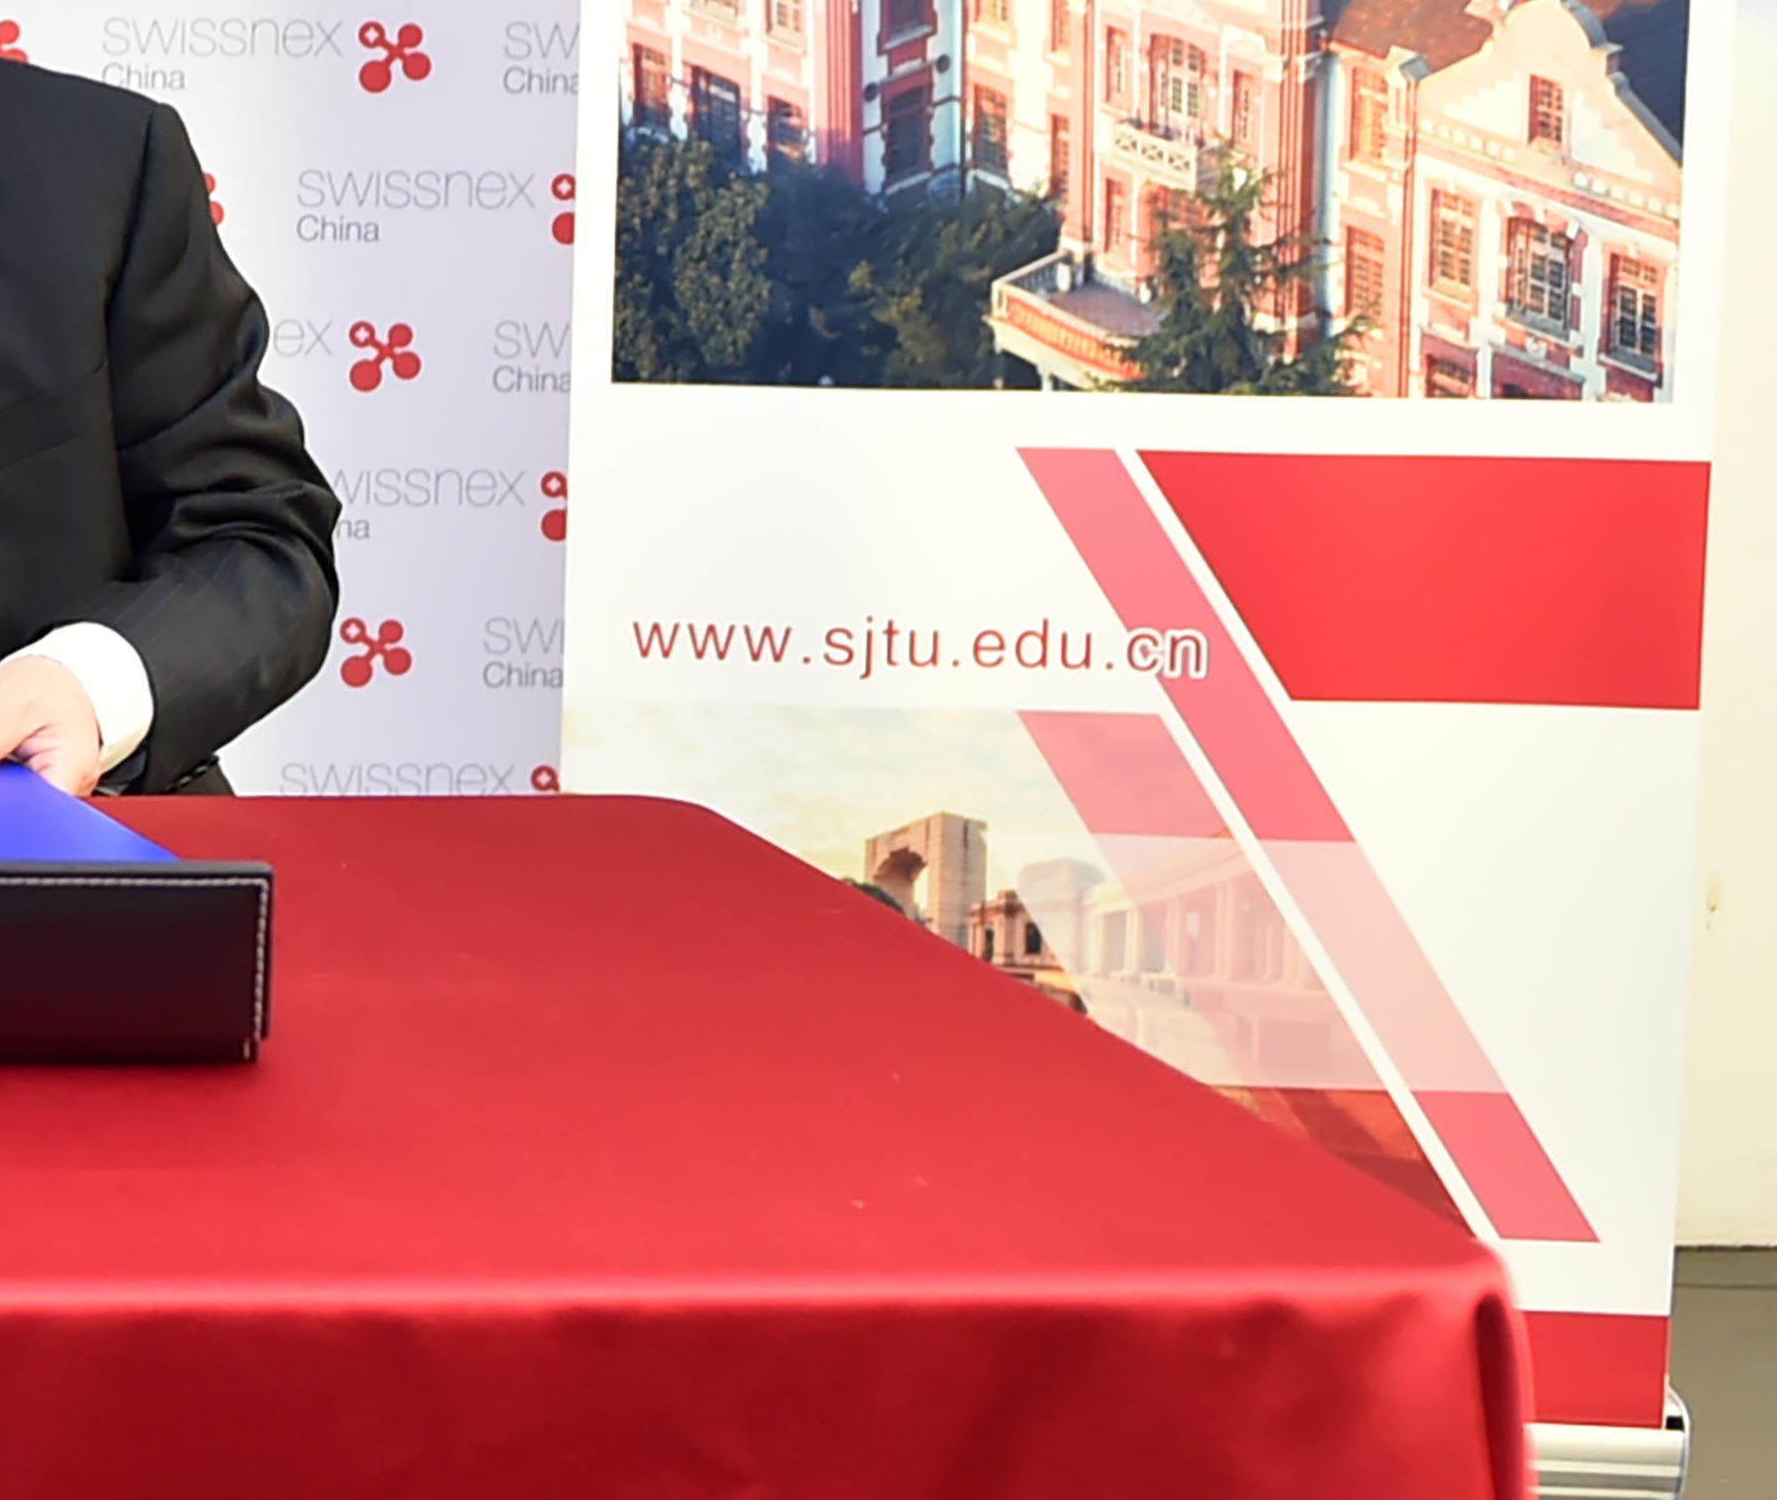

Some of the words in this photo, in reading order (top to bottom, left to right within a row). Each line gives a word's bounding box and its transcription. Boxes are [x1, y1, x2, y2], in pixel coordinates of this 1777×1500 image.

[101, 17, 341, 57] swissnex
[298, 169, 537, 209] swissnex
[296, 214, 380, 243] China
[632, 616, 1203, 679] www.sjtu.edu.cn
[482, 660, 564, 689] China
